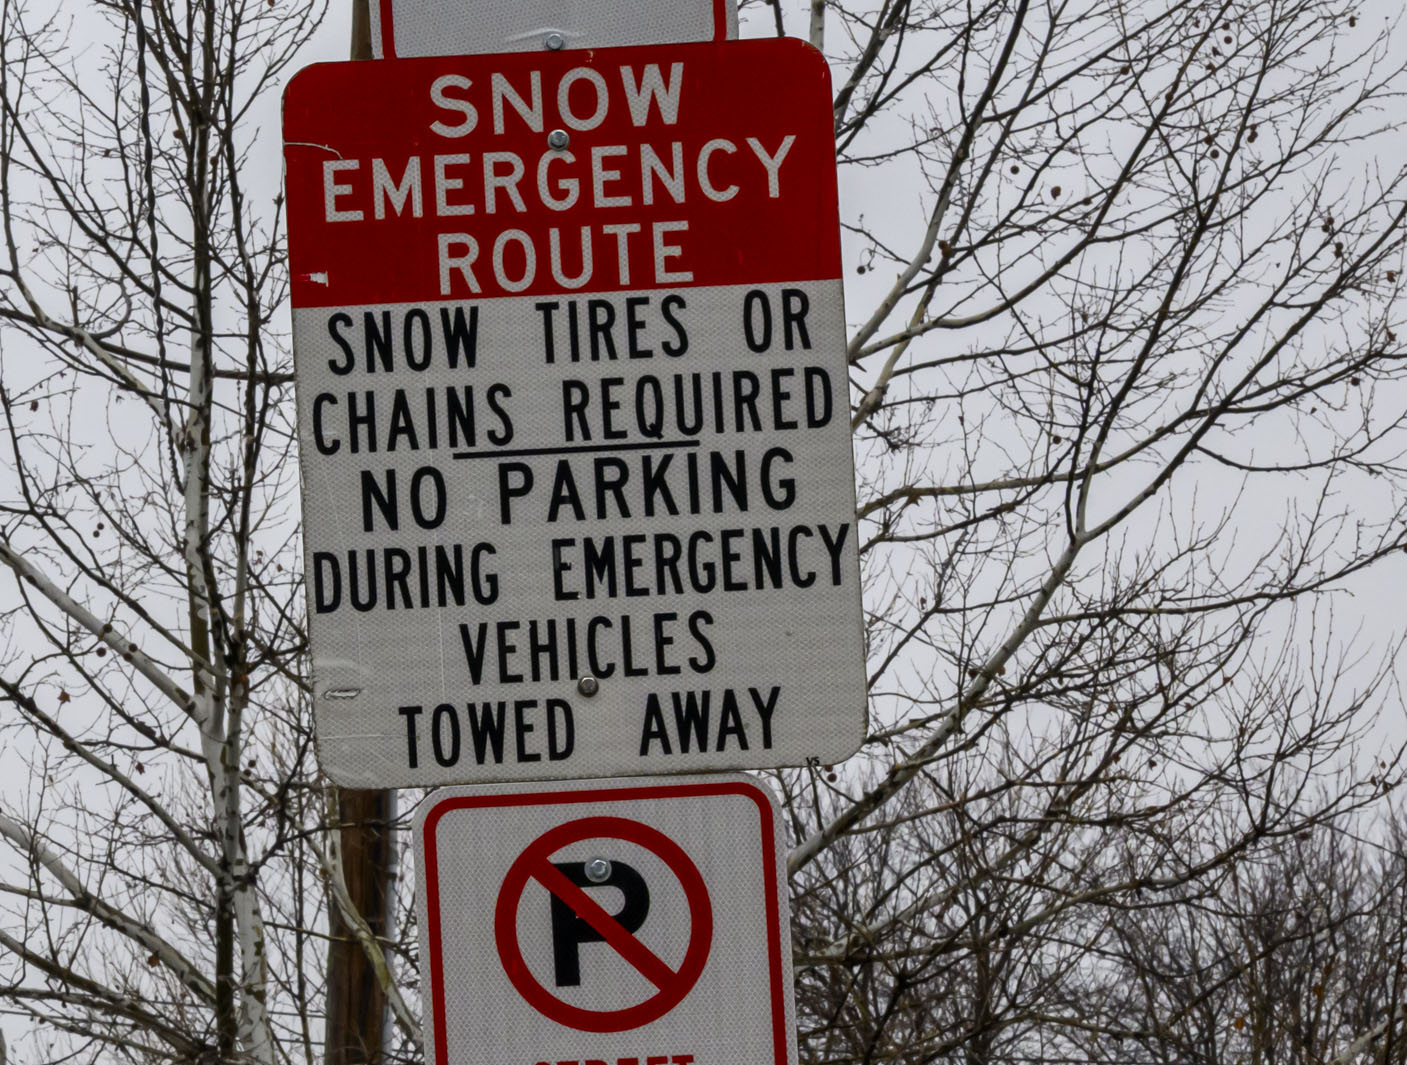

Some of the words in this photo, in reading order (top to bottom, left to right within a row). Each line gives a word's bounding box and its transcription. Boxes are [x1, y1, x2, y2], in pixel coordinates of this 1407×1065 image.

[430, 63, 684, 138] SNOW
[323, 136, 797, 223] EMERGENCY
[437, 221, 694, 295] ROUTE
[327, 306, 479, 376] SNOW
[535, 295, 689, 364] TIRES
[743, 289, 812, 354] OR
[312, 383, 514, 456] CHAINS
[563, 366, 833, 443] REQUIRED
[360, 466, 448, 533] NO
[498, 447, 797, 525] PARKING
[313, 542, 500, 615] DURING
[552, 523, 850, 602] EMERGENCY
[459, 610, 717, 686] VEHICLES
[398, 699, 575, 769] TOWED
[640, 686, 782, 757] AWAY
